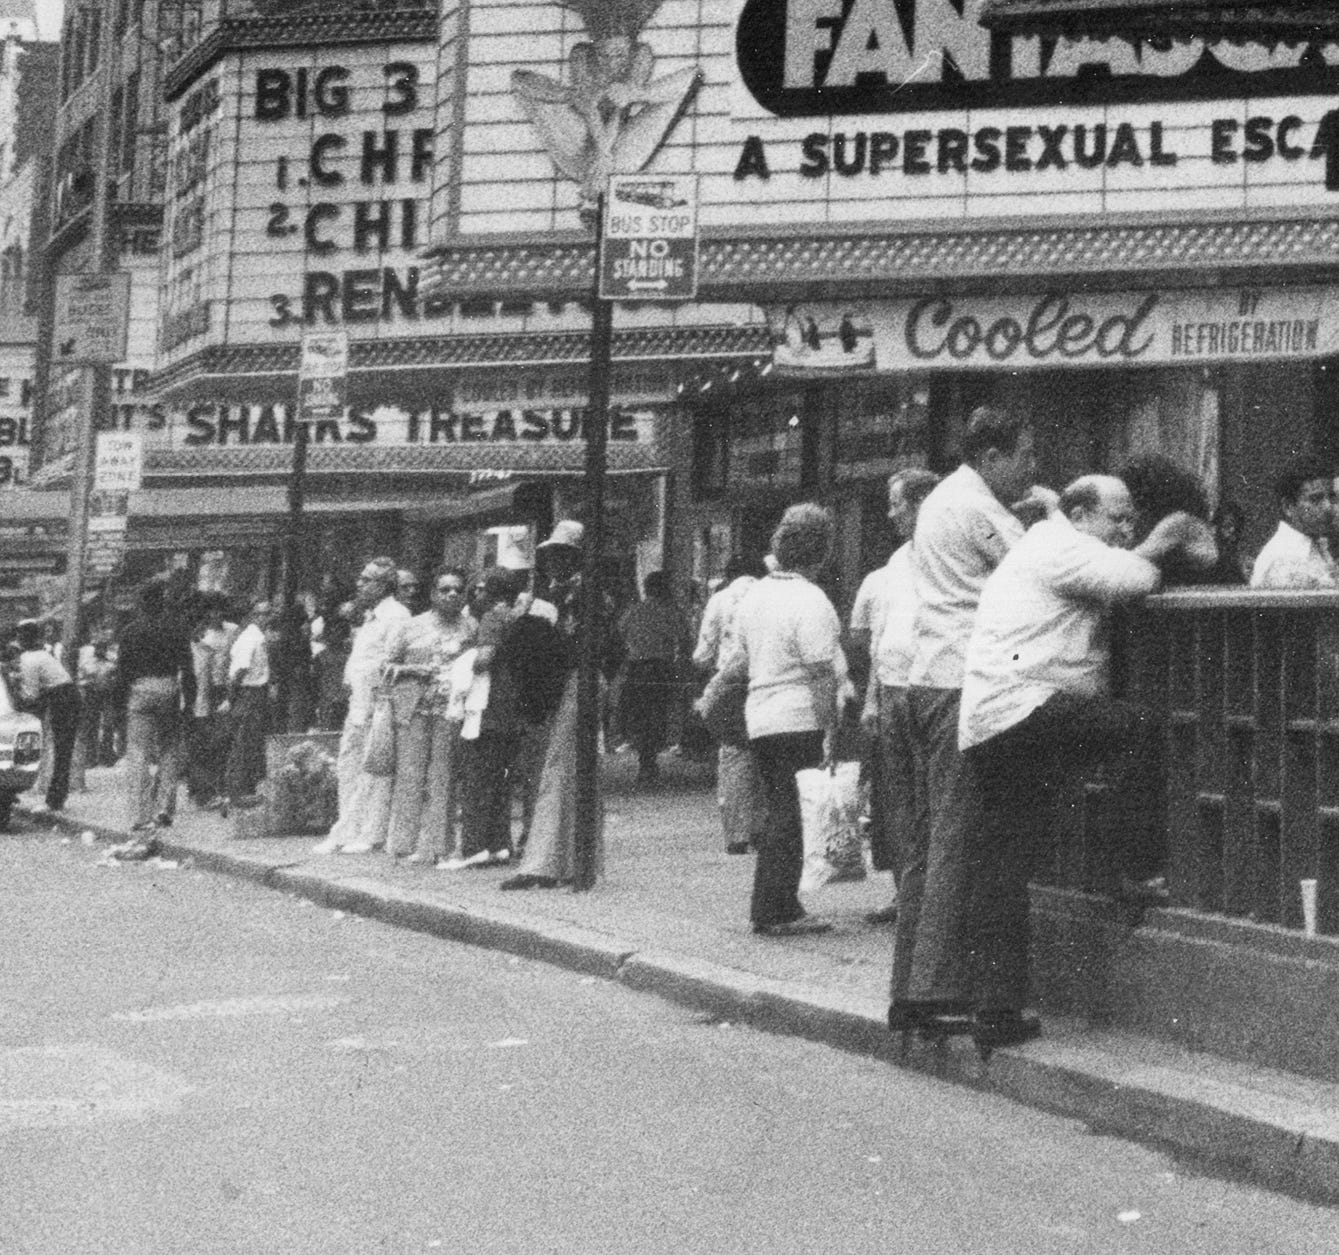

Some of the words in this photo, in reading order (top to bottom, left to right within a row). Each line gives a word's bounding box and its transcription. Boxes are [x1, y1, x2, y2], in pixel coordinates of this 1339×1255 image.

[255, 64, 351, 122] BIG
[382, 60, 420, 117] 3
[734, 135, 771, 182] A
[799, 121, 1178, 179] SUPERSEXUAL
[611, 215, 642, 234] BUS
[649, 214, 691, 233] STOP
[613, 258, 684, 280] STANDING
[629, 240, 670, 259] NO
[905, 289, 1161, 359] Cooled
[1171, 318, 1320, 355] REFRIGERATION
[184, 403, 378, 446] SHAKS
[408, 407, 640, 444] TREASUE
